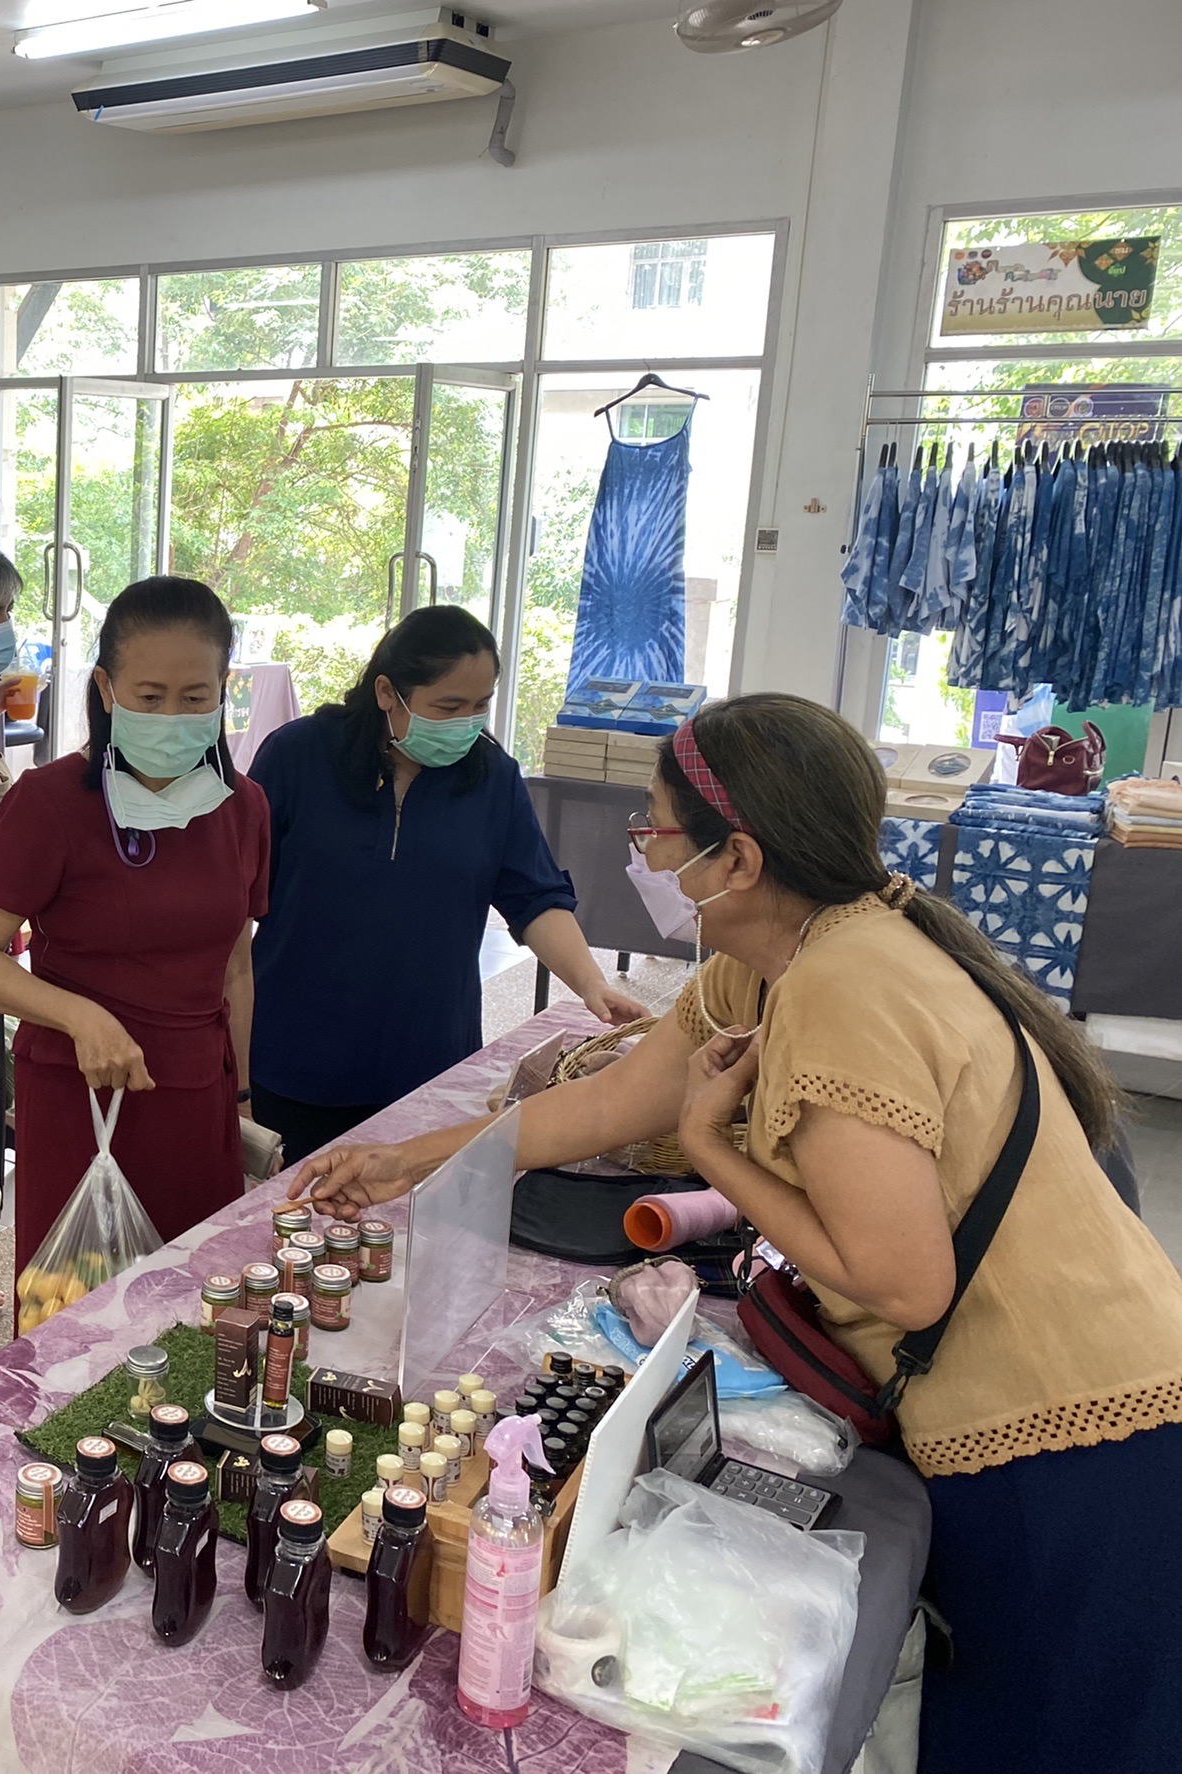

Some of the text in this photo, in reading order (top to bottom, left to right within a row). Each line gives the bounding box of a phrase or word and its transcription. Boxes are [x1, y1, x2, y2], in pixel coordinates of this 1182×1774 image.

[948, 286, 1148, 321] ร้านร้านคุณนาย
